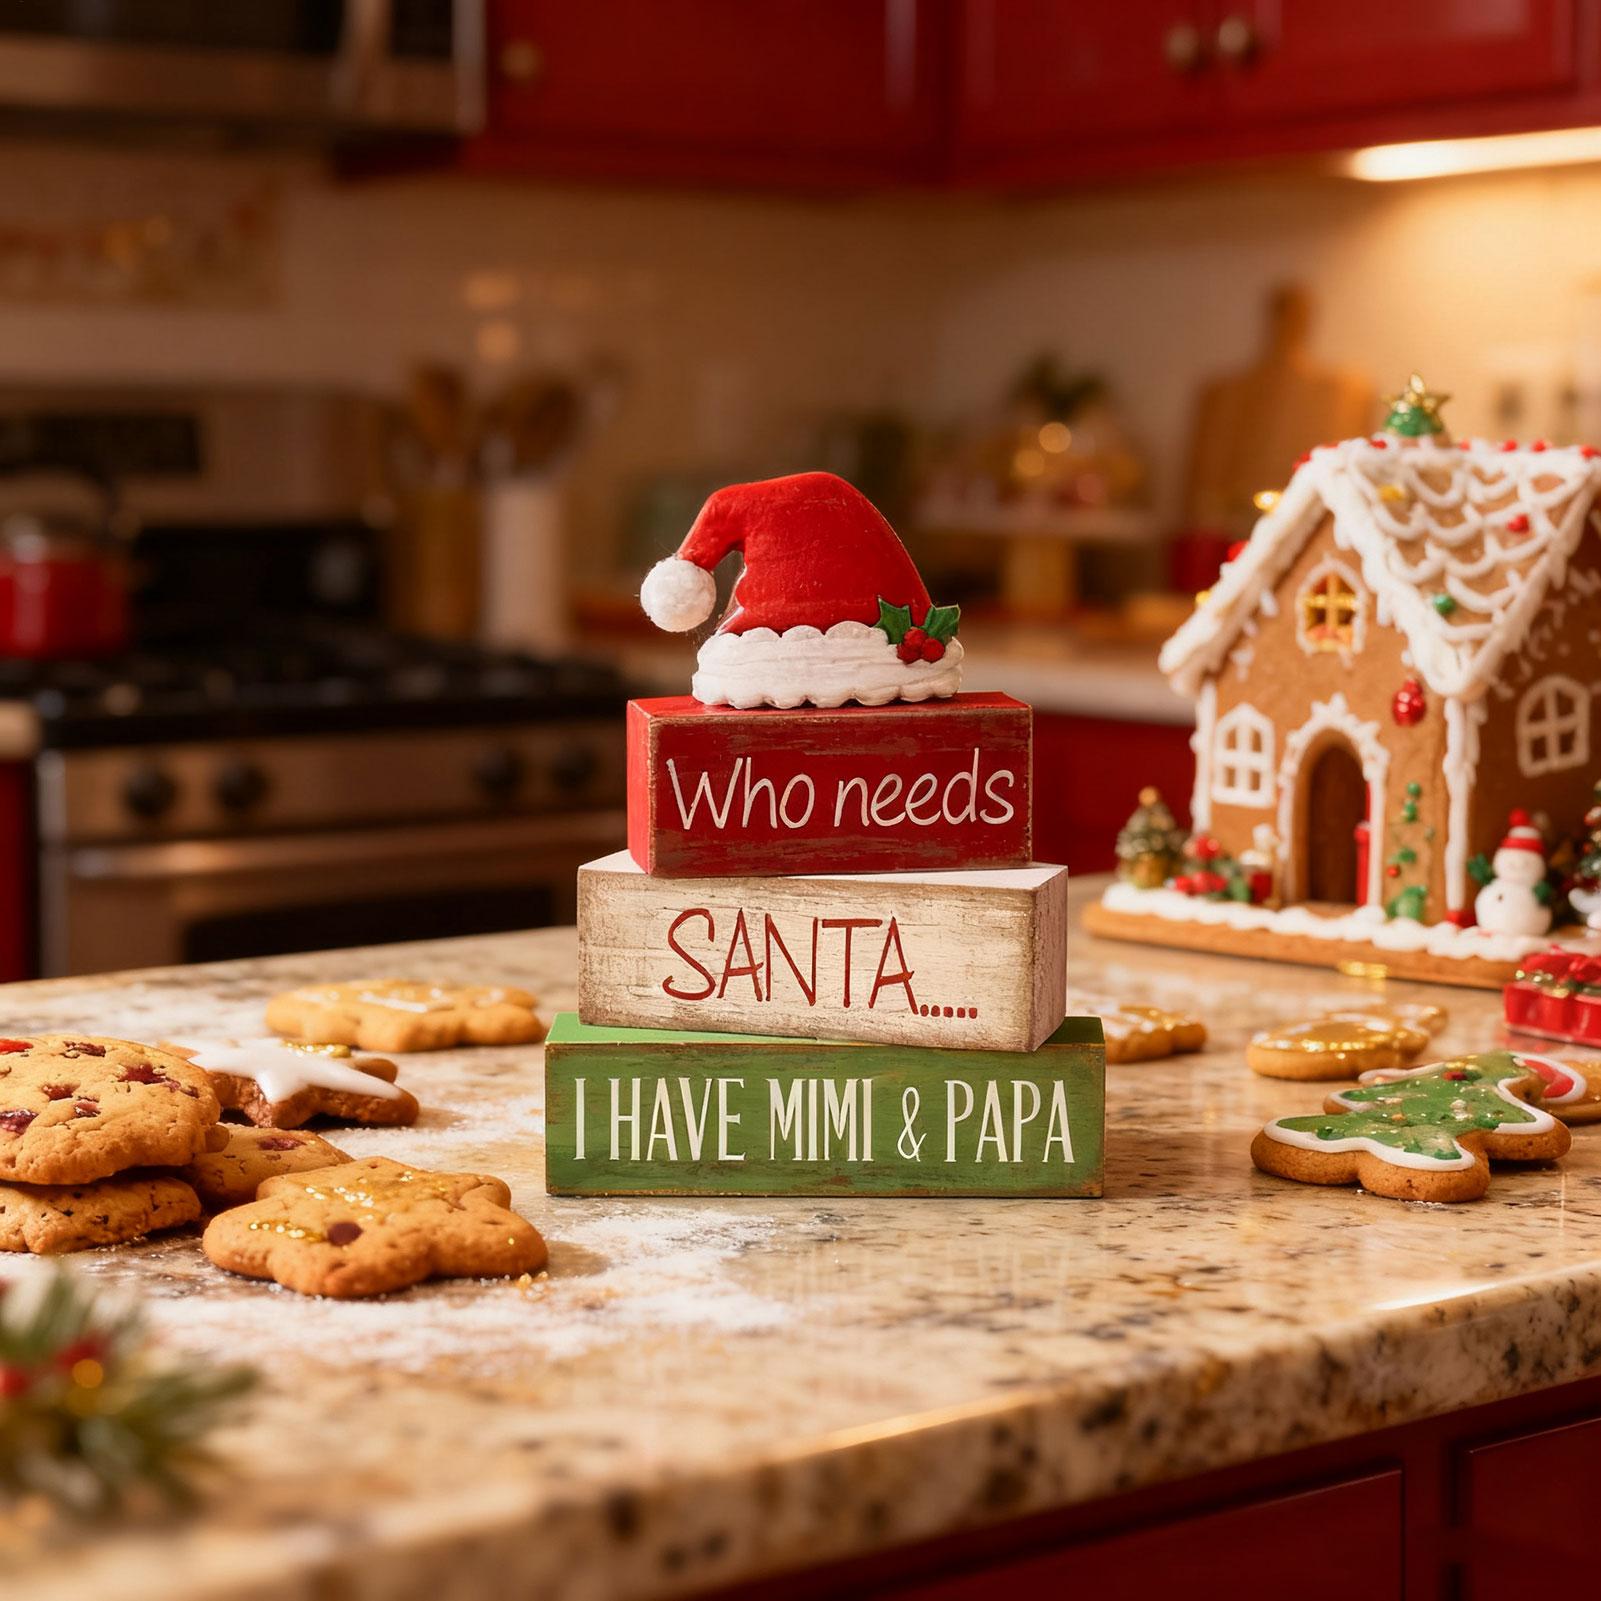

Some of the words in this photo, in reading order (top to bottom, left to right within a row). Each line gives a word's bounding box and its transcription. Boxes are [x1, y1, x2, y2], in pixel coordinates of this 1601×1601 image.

[666, 757, 814, 829] Who
[833, 748, 1014, 828] needs
[663, 908, 978, 1019] SANTA.....
[573, 1078, 587, 1161] I
[608, 1077, 746, 1162] HAVE
[766, 1078, 874, 1162] MIMI
[897, 1086, 927, 1162] &
[944, 1080, 1075, 1163] PAPA
